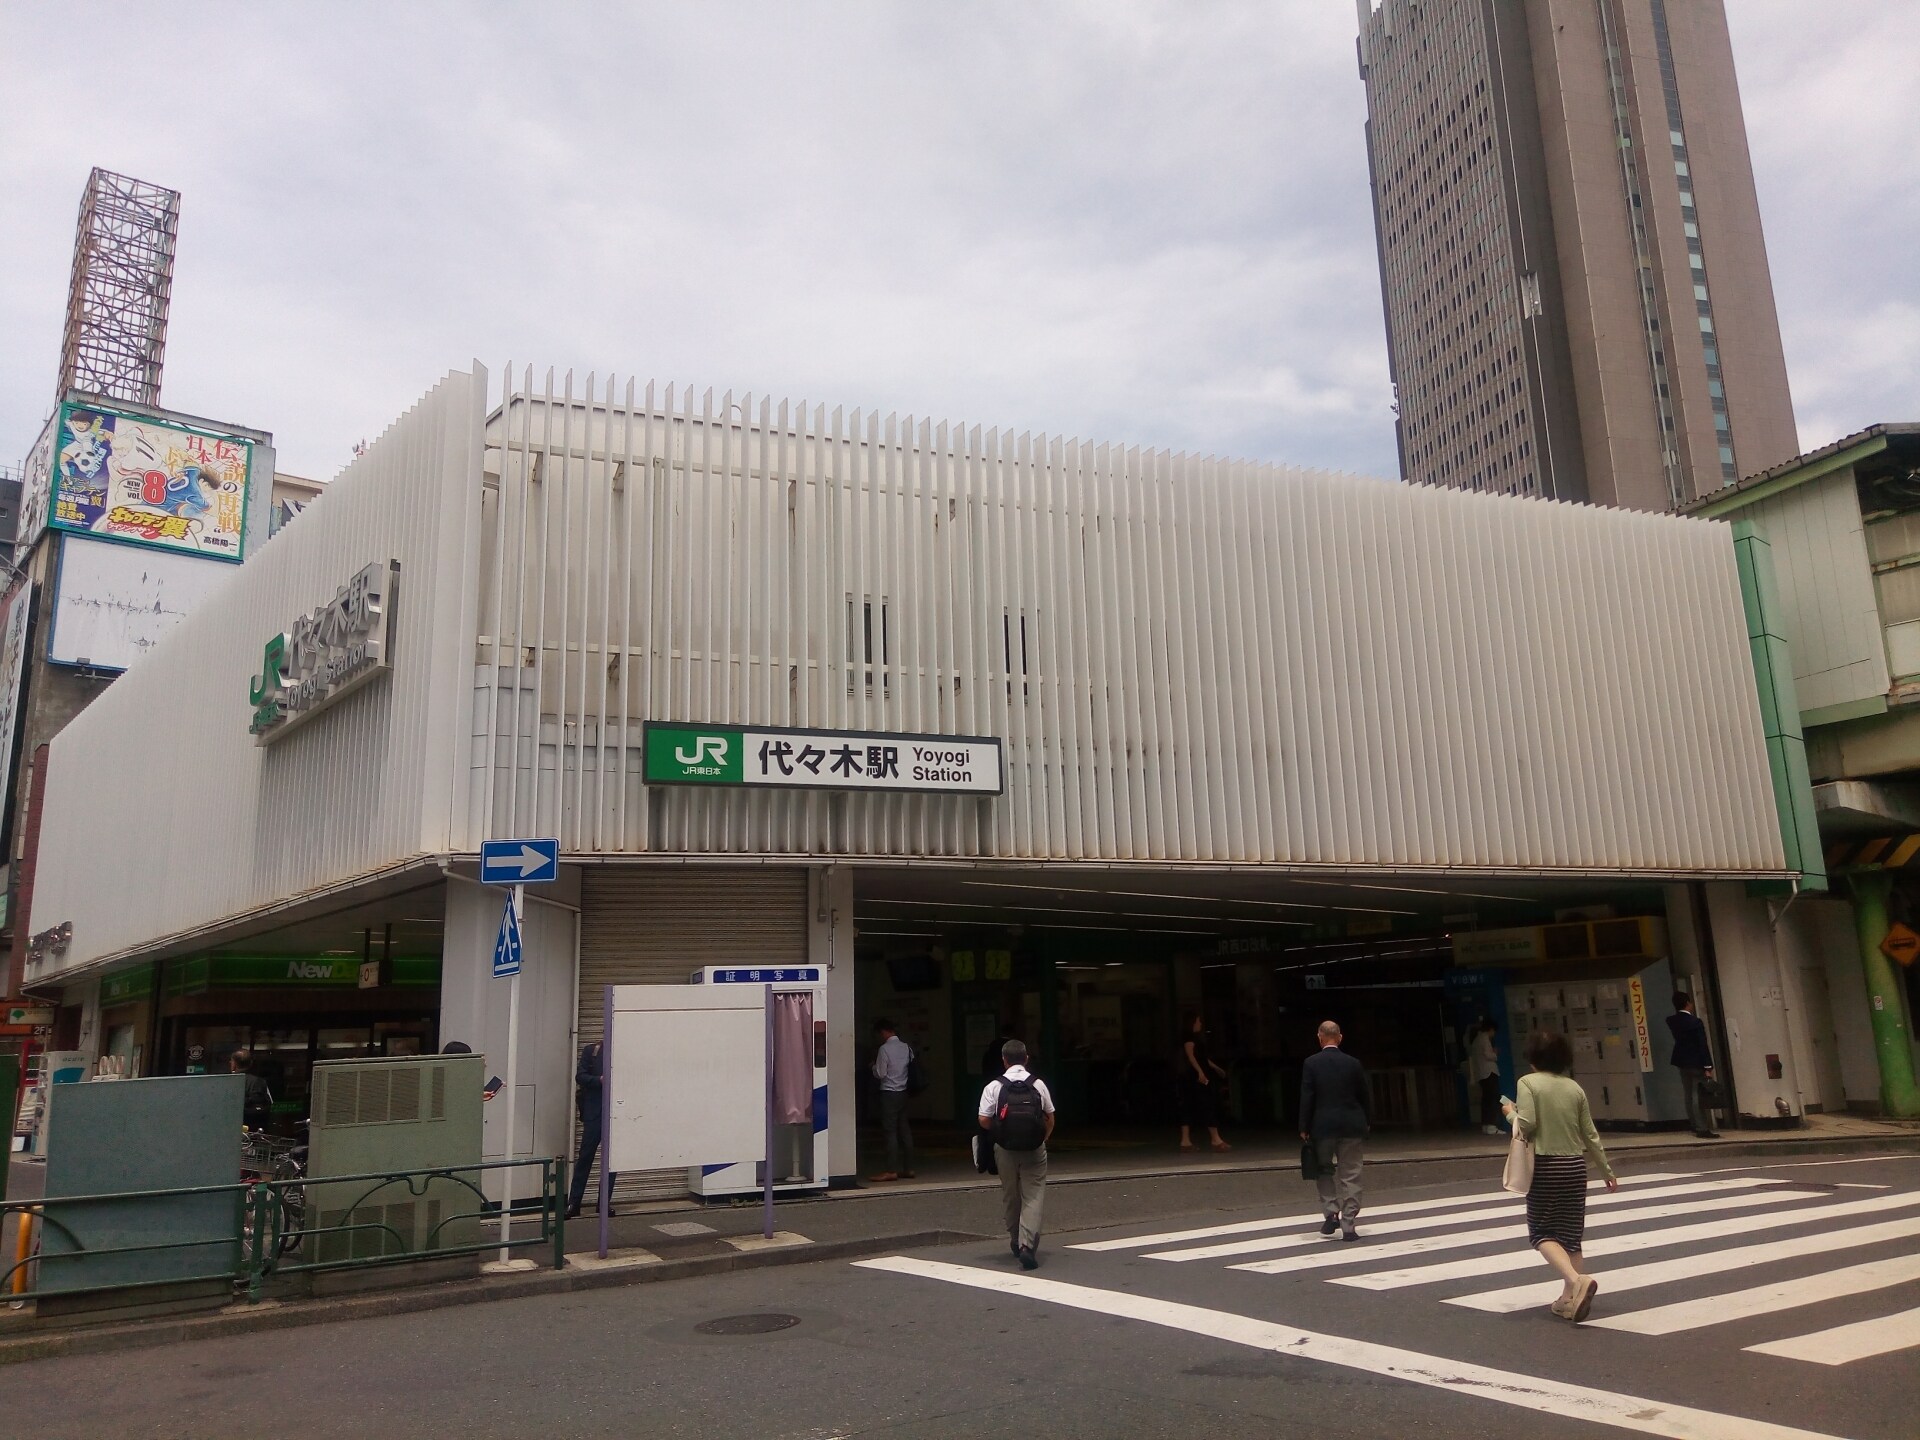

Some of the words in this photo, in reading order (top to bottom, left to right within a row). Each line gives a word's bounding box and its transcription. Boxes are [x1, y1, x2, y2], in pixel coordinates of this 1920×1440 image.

[126, 480, 141, 488] NEW
[142, 470, 167, 505] 8
[249, 632, 287, 707] JR
[675, 736, 728, 766] JR
[758, 740, 899, 779] 代々木駅
[912, 747, 970, 766] Yoyogi
[681, 766, 722, 776] JR東日本
[912, 766, 973, 783] Station
[725, 969, 809, 982] 証明写真
[33, 1026, 46, 1035] 2F
[1631, 993, 1649, 1068] コインロッカー
